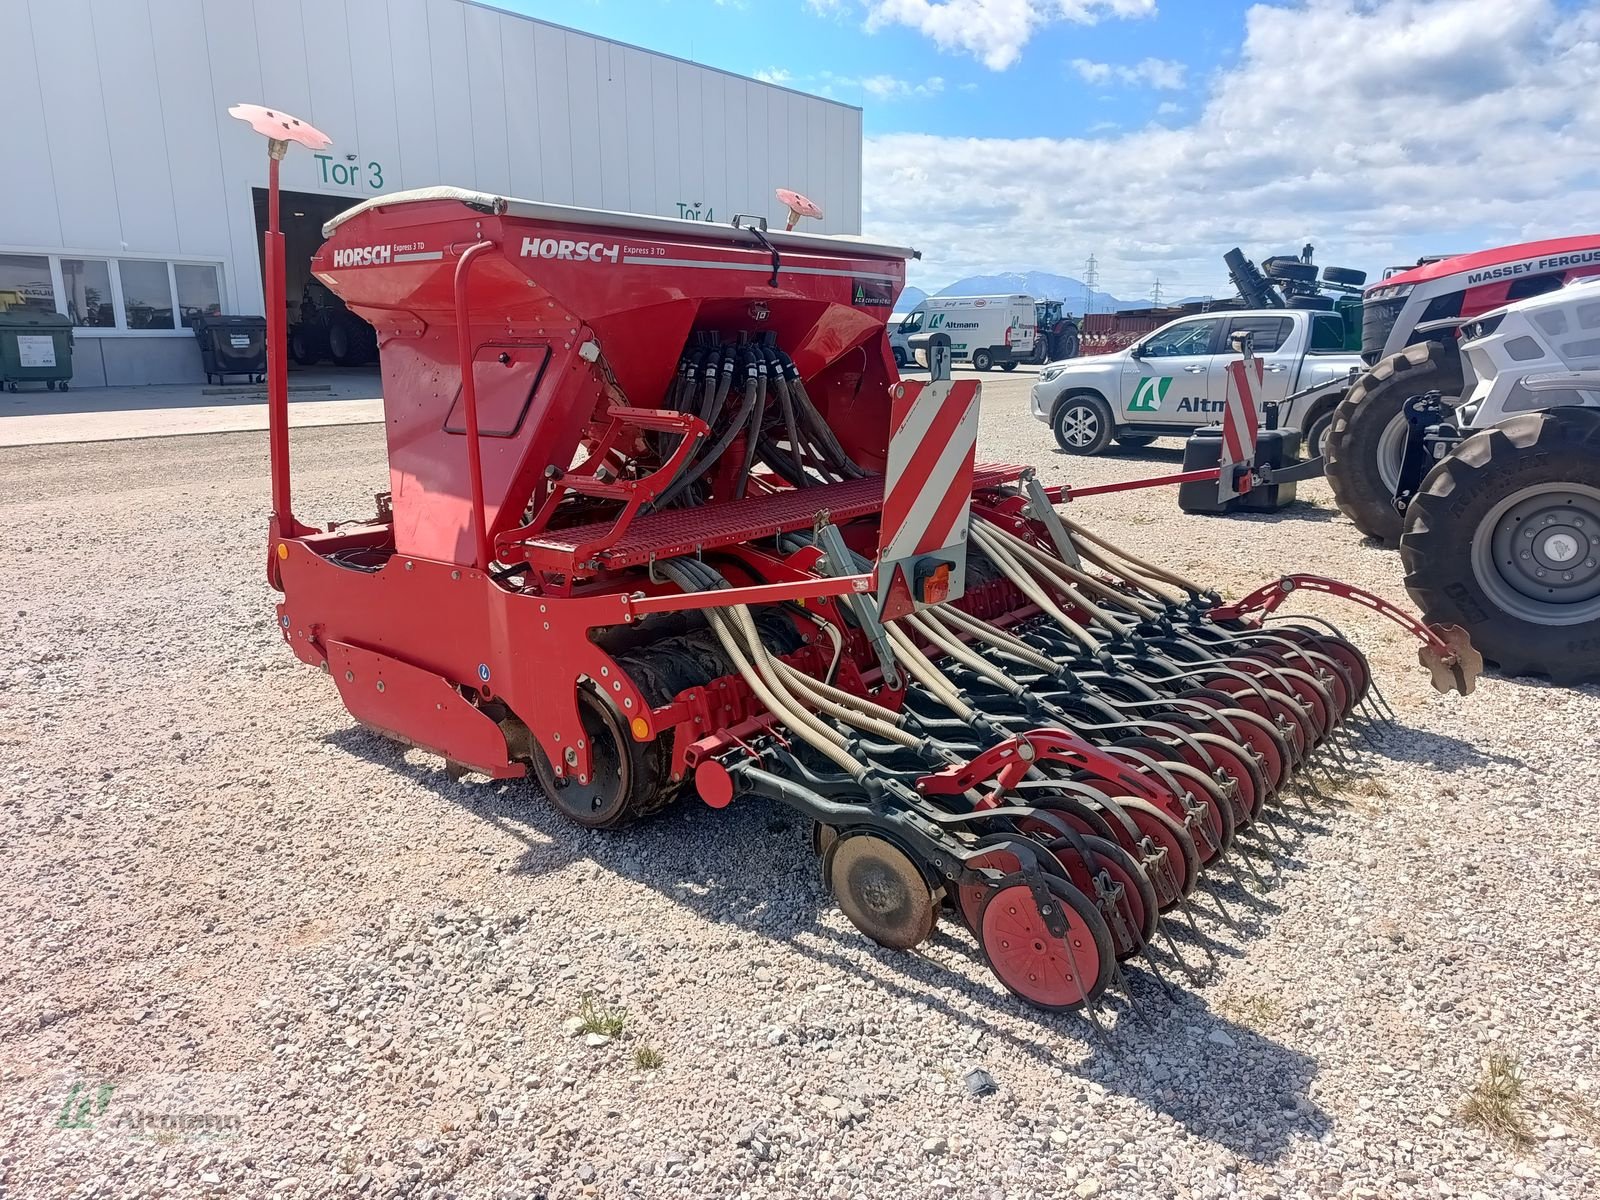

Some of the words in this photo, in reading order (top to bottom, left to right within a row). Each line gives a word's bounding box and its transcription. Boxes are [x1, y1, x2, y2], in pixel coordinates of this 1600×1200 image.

[314, 154, 359, 186] Tor
[368, 161, 384, 189] 3
[676, 202, 701, 221] Tor
[705, 207, 714, 223] 4
[333, 245, 391, 268] HORSCH
[393, 243, 412, 252] Express
[520, 237, 620, 264] HORSCH
[623, 245, 649, 255] Express
[650, 247, 655, 255] 3
[656, 247, 666, 256] TD
[1467, 261, 1534, 285] MASSEY
[945, 321, 979, 329] Altmann
[1176, 397, 1268, 413] Altm
